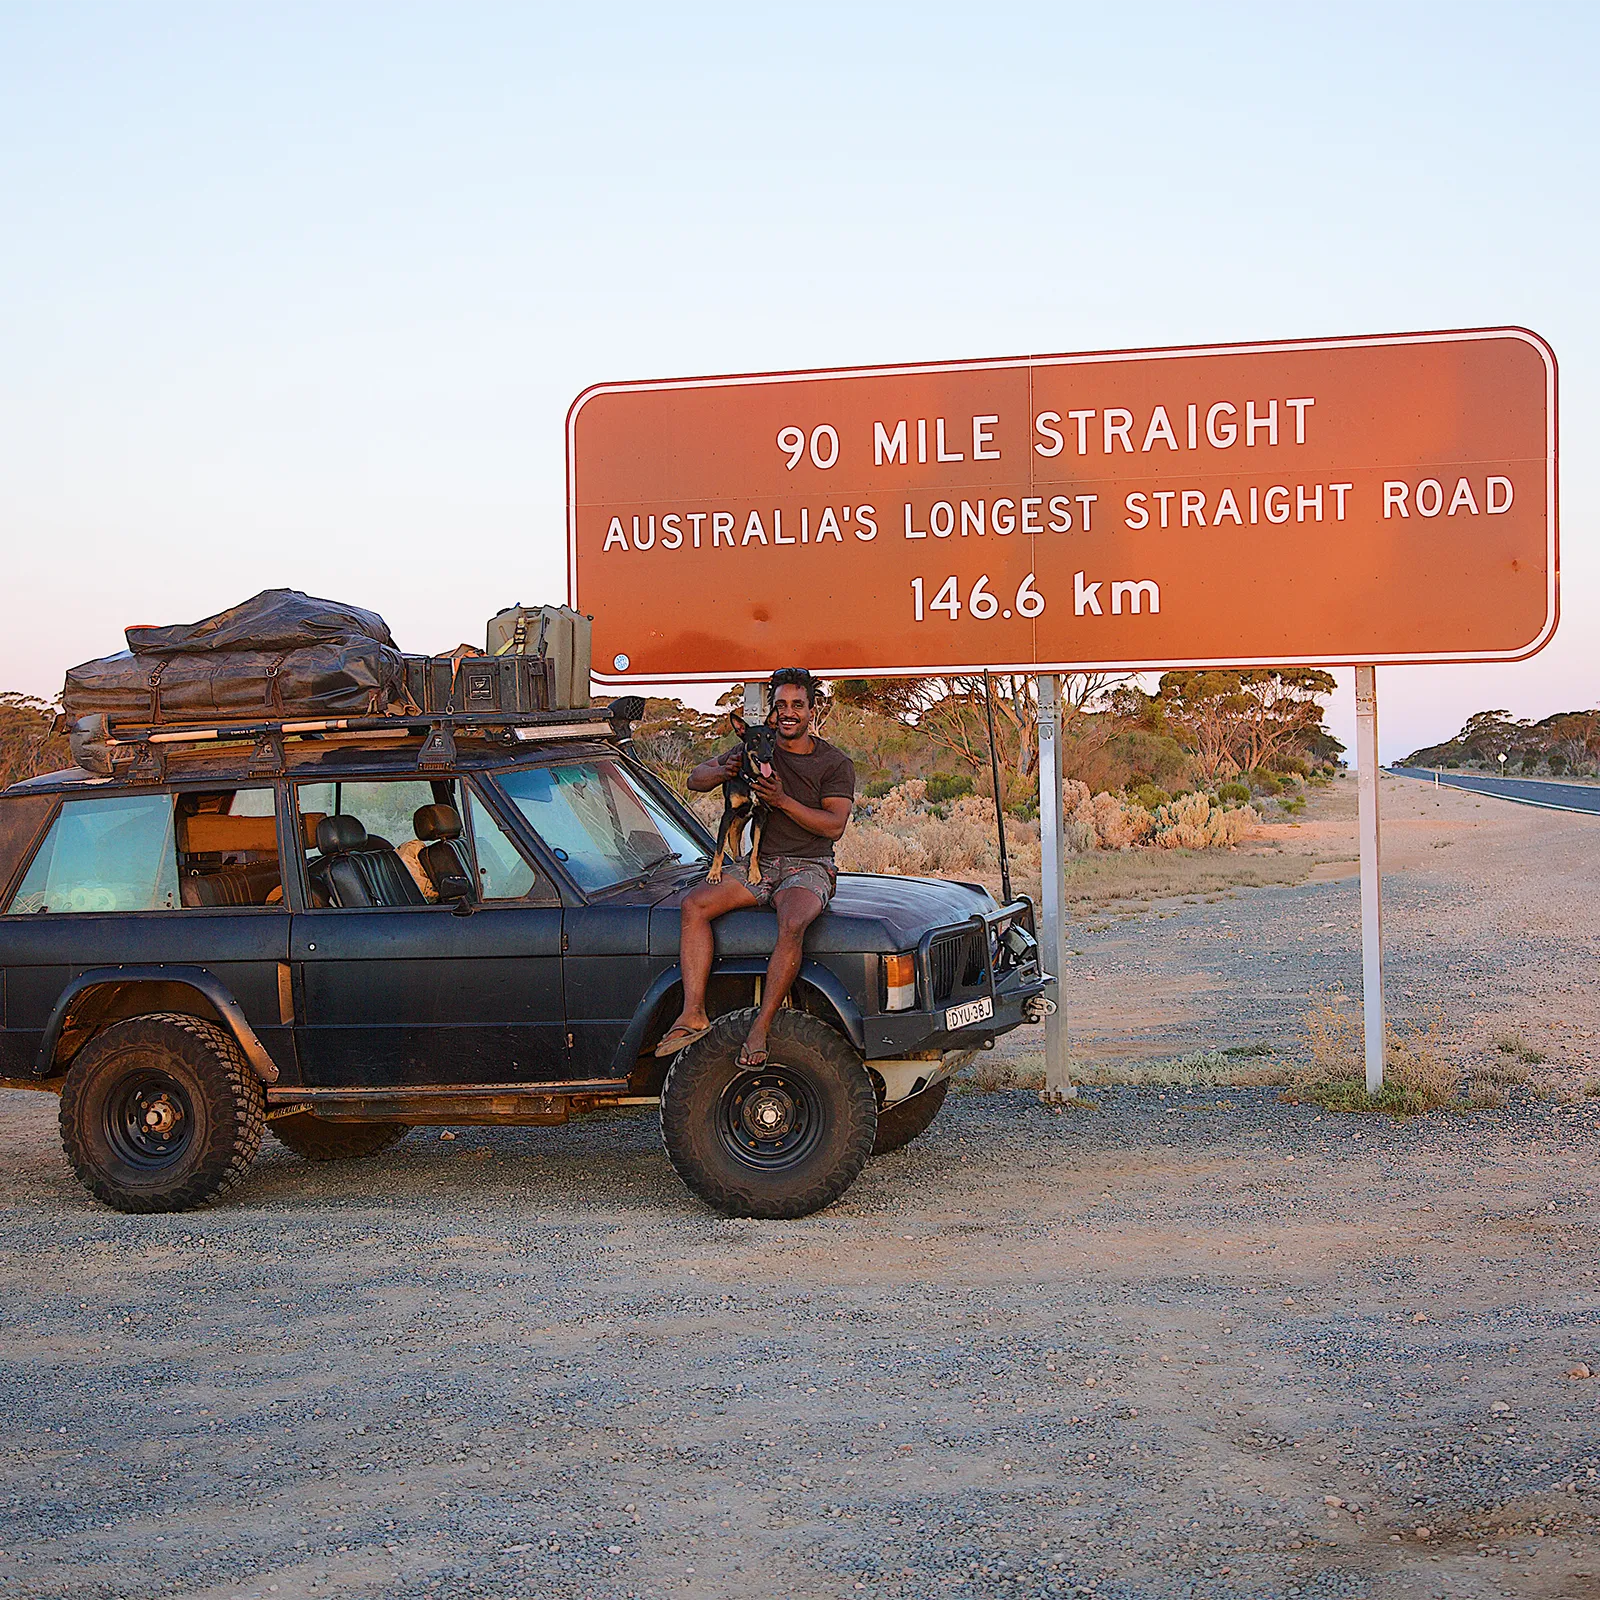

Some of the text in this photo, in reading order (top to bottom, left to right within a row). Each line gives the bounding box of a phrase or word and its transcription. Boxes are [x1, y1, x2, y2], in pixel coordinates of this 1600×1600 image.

[776, 397, 1316, 471] 90 MILE STRAIGHT
[602, 475, 1515, 553] AUSTRALIA'S LONGEST STRAIGHT ROAD
[909, 570, 1162, 622] 146.6 km
